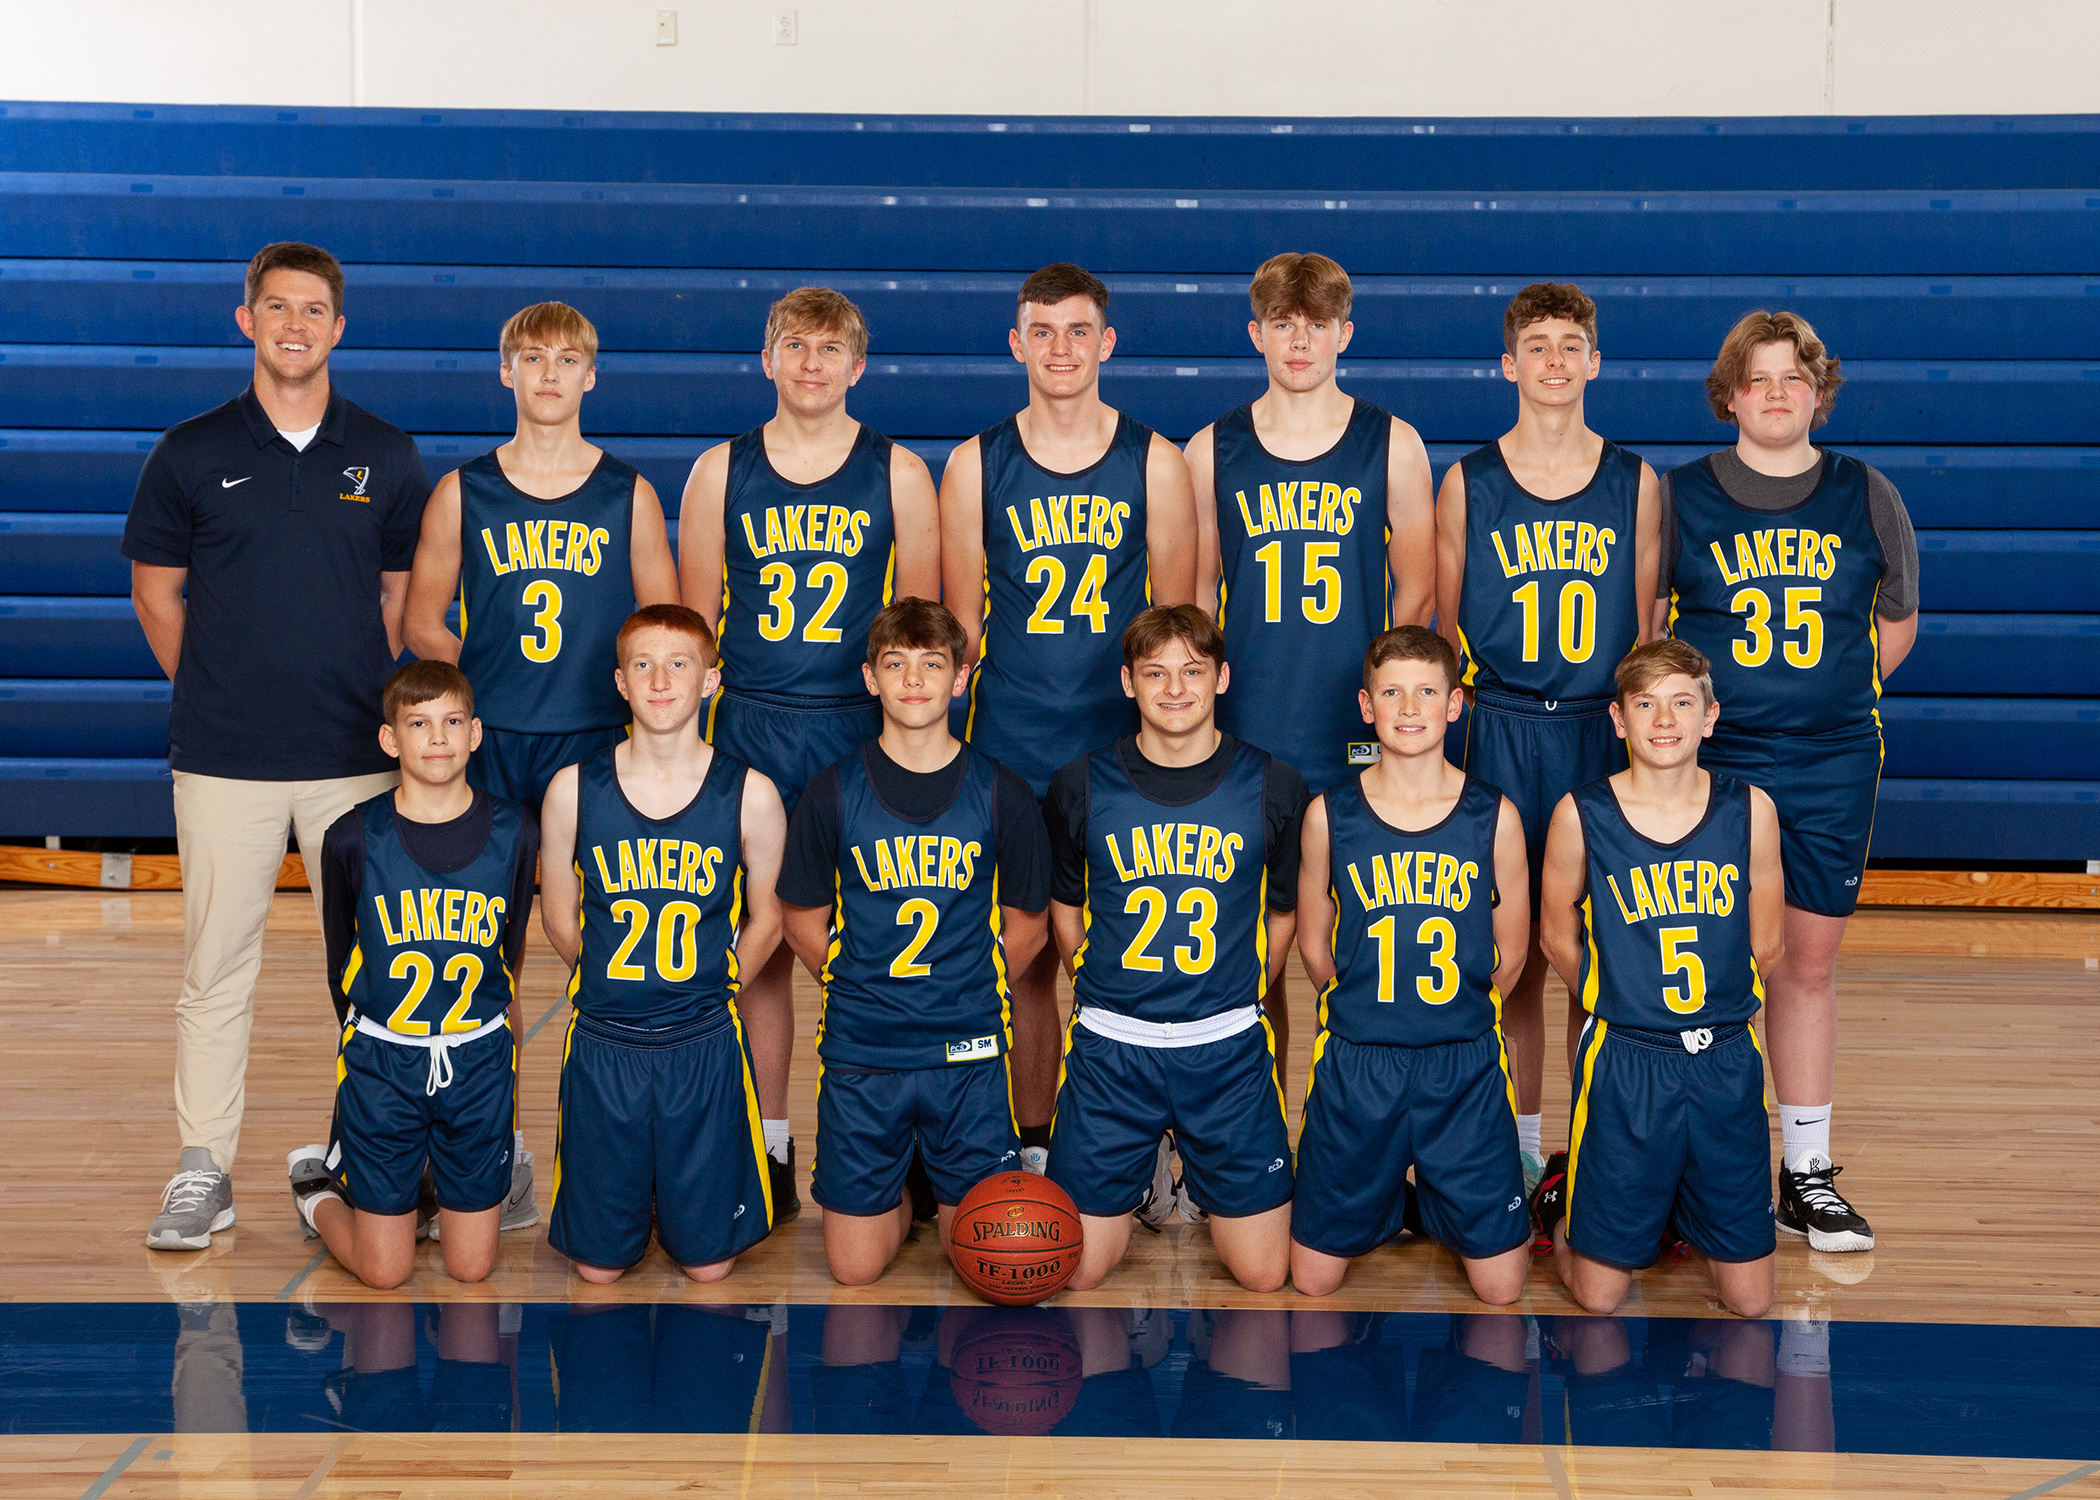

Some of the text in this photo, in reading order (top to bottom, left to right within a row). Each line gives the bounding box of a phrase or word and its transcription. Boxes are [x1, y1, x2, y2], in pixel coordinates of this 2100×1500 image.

[339, 493, 370, 503] LAKERS
[1006, 494, 1131, 553] LAKERS
[1235, 480, 1362, 538] LAKERS
[481, 519, 610, 577] LAKERS
[740, 504, 871, 560] LAKERS
[1490, 520, 1617, 579] LAKERS
[1709, 527, 1843, 586] LAKERS
[757, 561, 849, 643] 32
[1025, 553, 1110, 635] 24
[1255, 540, 1342, 625] 15
[520, 579, 563, 663] 3
[1512, 579, 1597, 664] 10
[1730, 586, 1824, 669] 35
[592, 837, 724, 897] LAKERS
[850, 835, 983, 893] LAKERS
[1105, 822, 1244, 884] LAKERS
[1346, 851, 1480, 913] LAKERS
[374, 888, 507, 948] LAKERS
[1606, 860, 1740, 925] LAKERS
[606, 898, 702, 983] 20
[889, 897, 940, 979] 2
[1121, 885, 1219, 975] 23
[1367, 915, 1461, 1006] 13
[386, 950, 484, 1037] 22
[1658, 926, 1707, 1015] 5
[977, 1038, 992, 1049] SM
[972, 1220, 1060, 1243] SPALDING
[976, 1259, 1061, 1280] TF-1000
